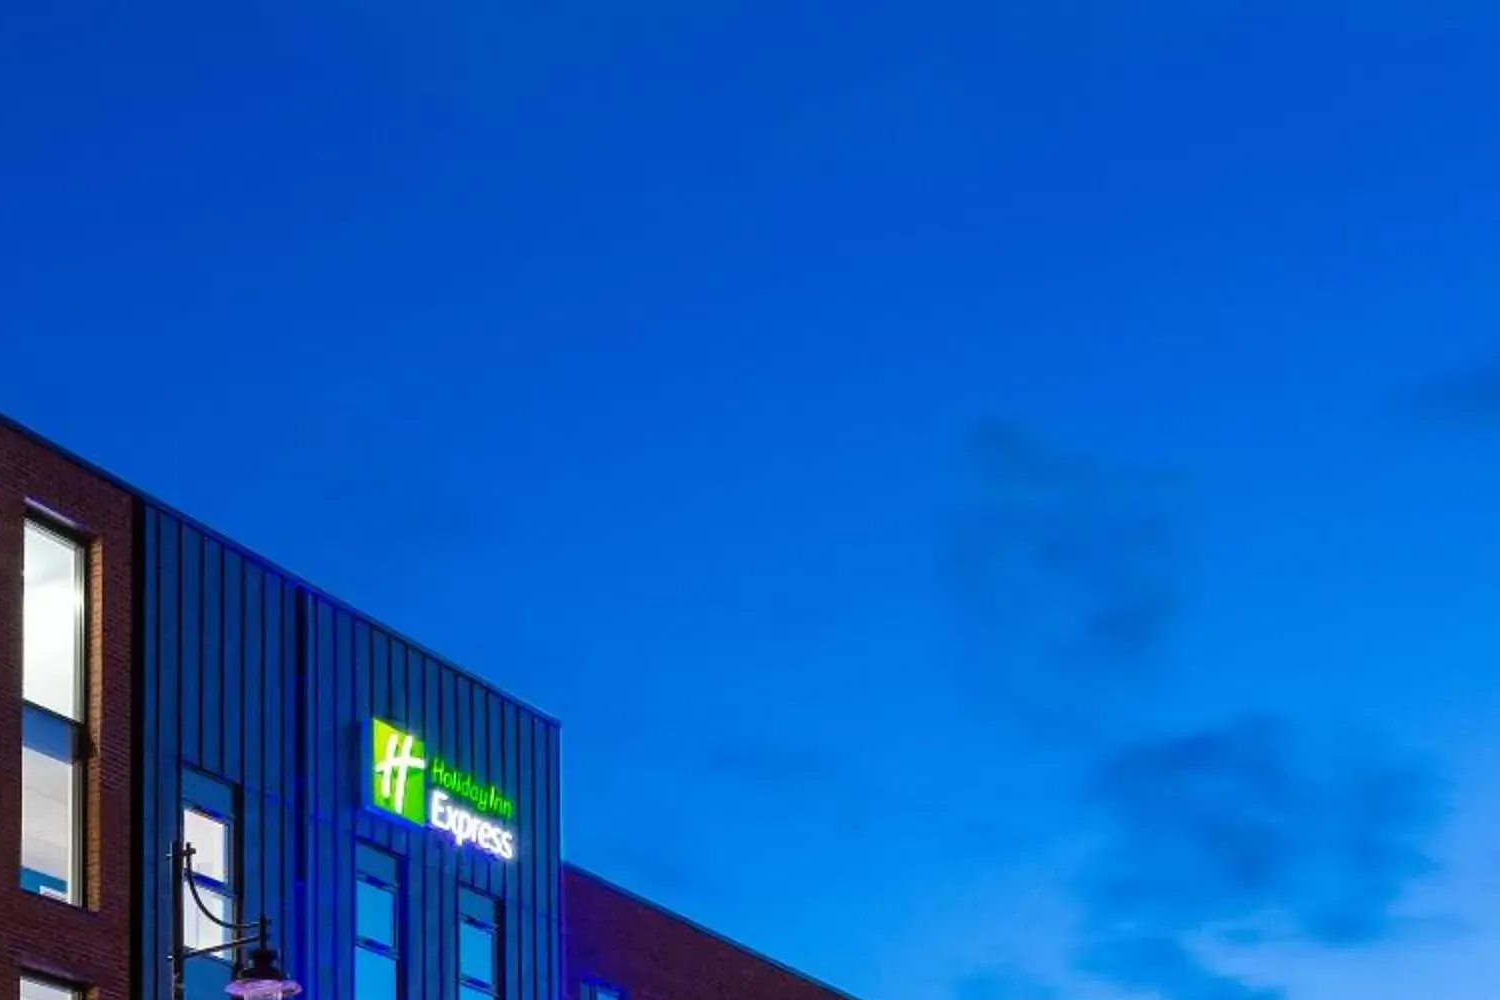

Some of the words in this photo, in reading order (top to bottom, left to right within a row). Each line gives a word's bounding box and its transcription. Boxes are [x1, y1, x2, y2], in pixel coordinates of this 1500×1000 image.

[432, 757, 489, 811] Holiday
[489, 787, 513, 819] Inn
[430, 789, 513, 860] Express
